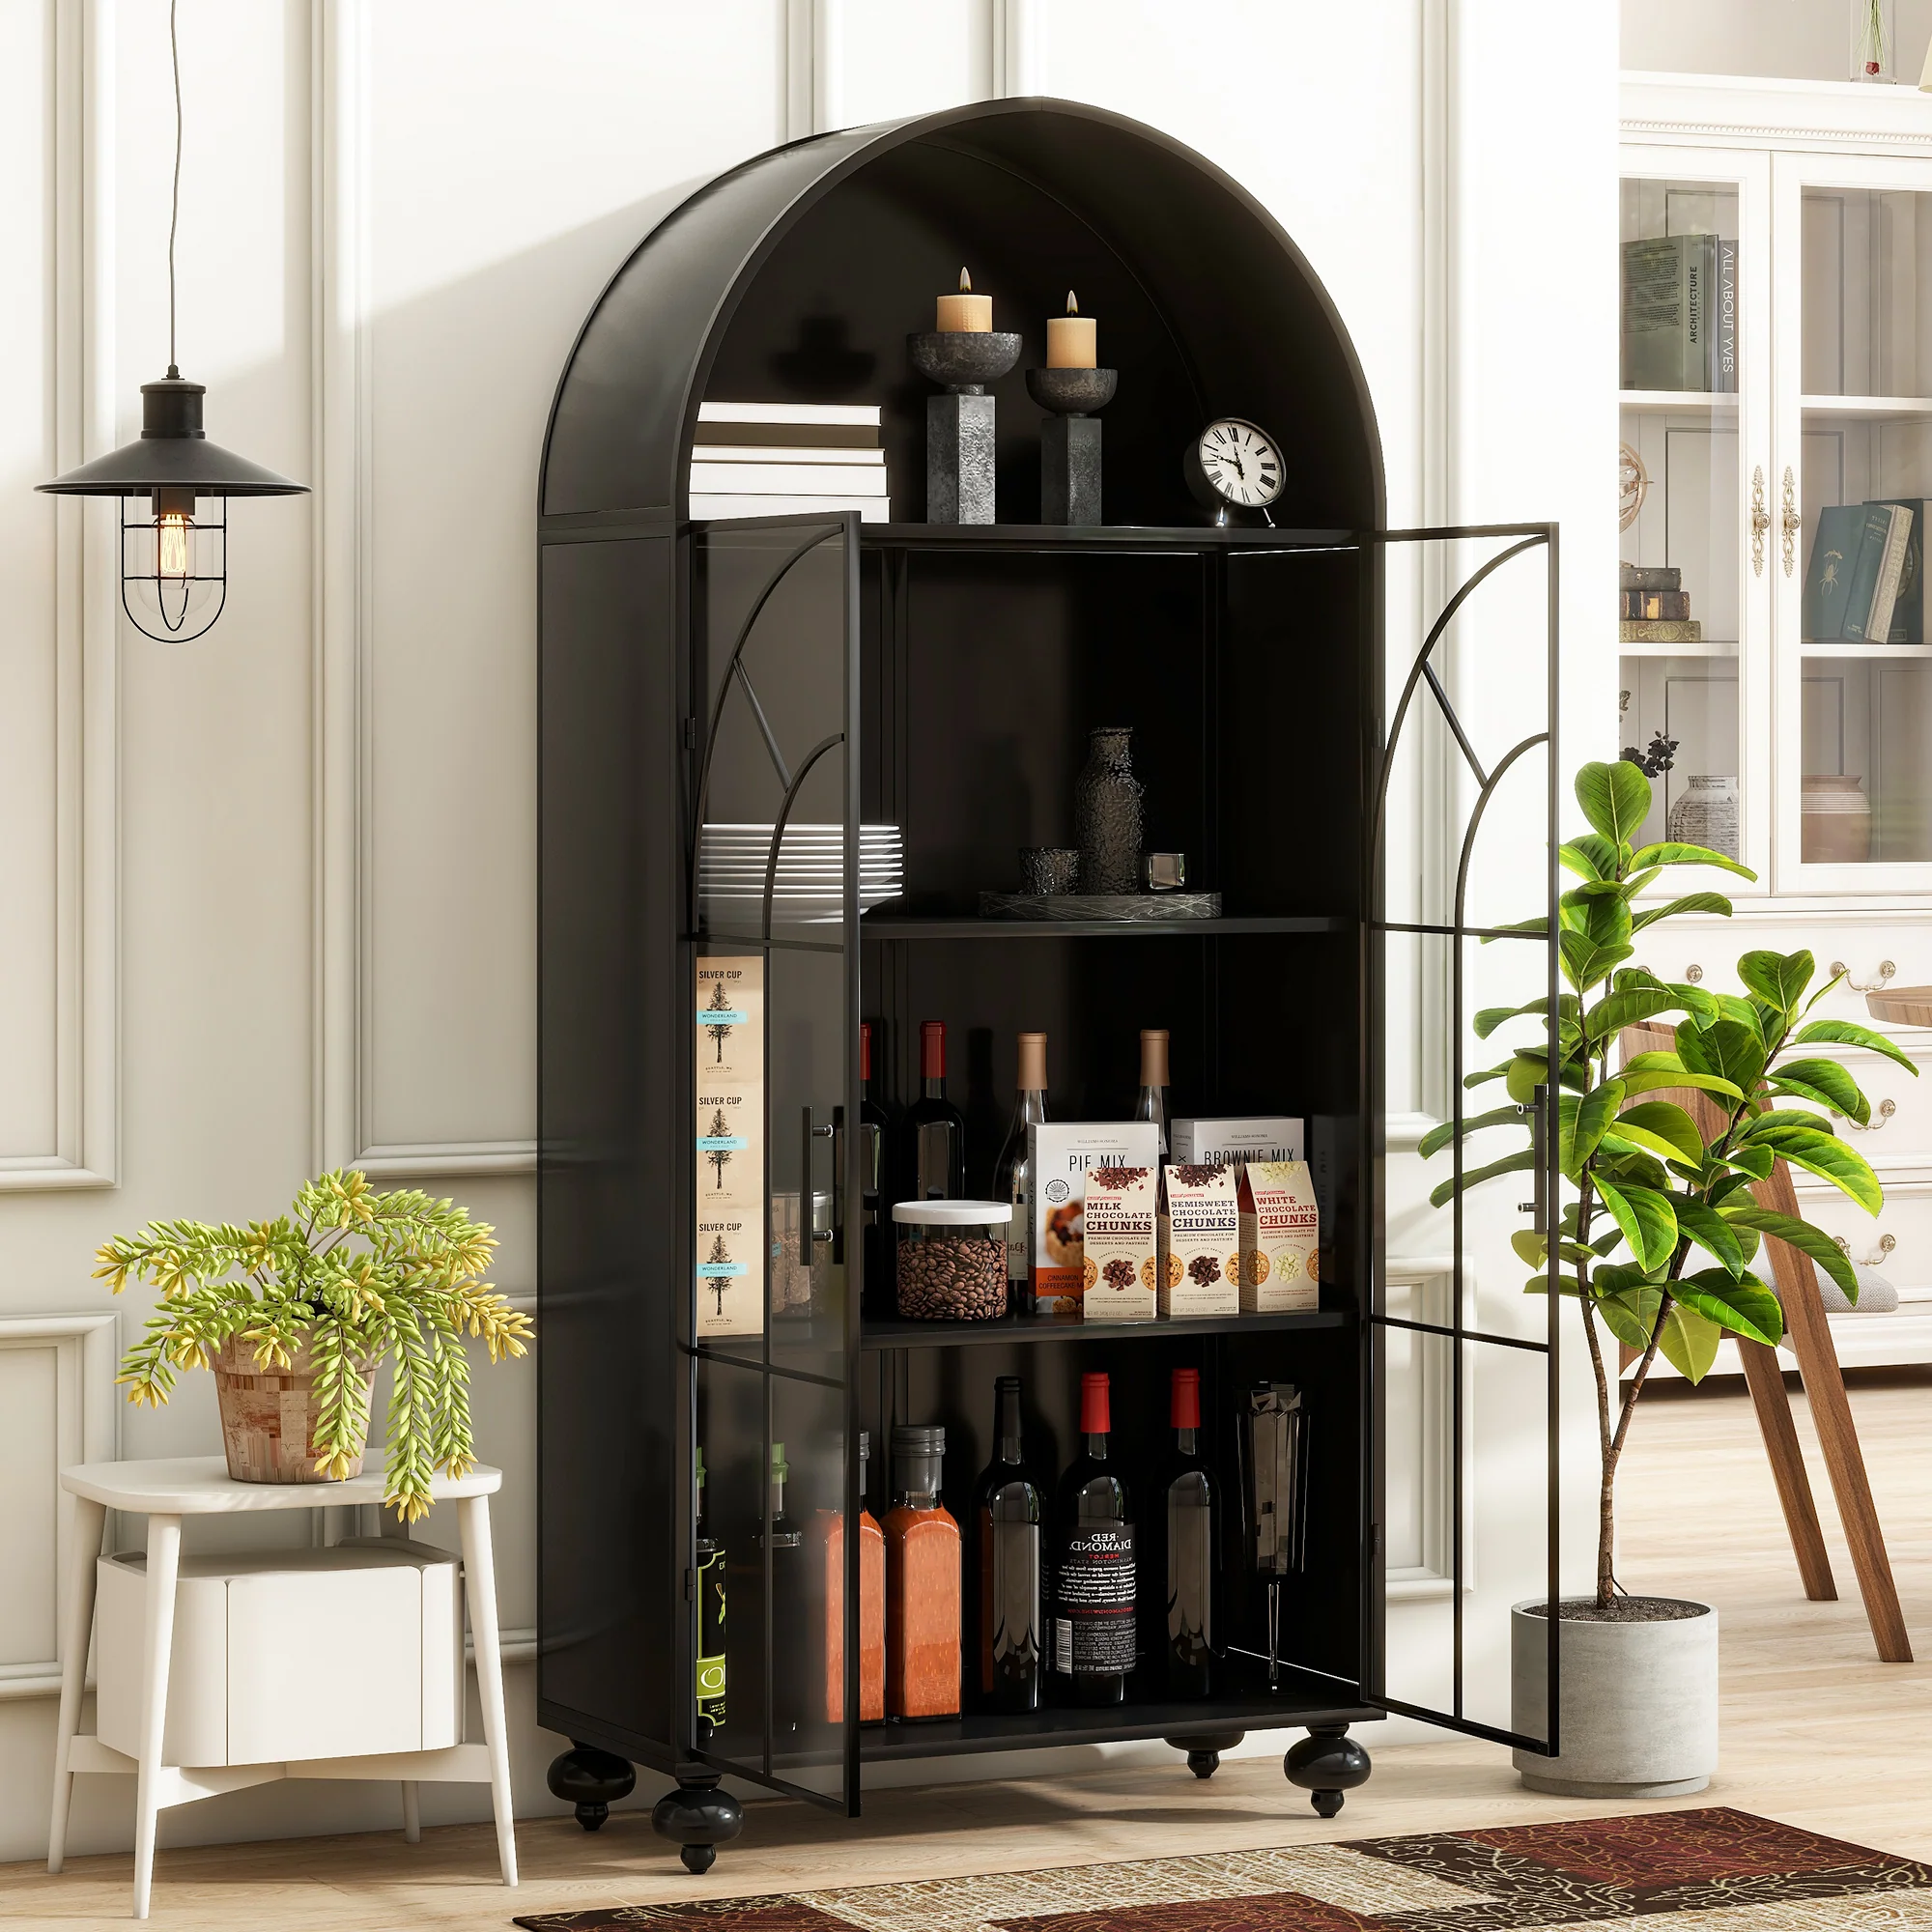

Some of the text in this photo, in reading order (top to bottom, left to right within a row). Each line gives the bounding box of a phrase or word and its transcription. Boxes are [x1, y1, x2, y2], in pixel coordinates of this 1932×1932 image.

[1722, 247, 1734, 373] ALL ABOUT YVES
[698, 1096, 742, 1105] SILVER CUP
[1069, 1154, 1125, 1171] PIE MIX
[1205, 1149, 1294, 1166] BROWNIE MIX
[1256, 1196, 1296, 1205] WHITE
[1259, 1205, 1316, 1213] CHOCOLATE
[1173, 1217, 1236, 1228] CHUNKS
[1260, 1213, 1317, 1225] CHUNKS
[1086, 1221, 1151, 1231] CHUNKS
